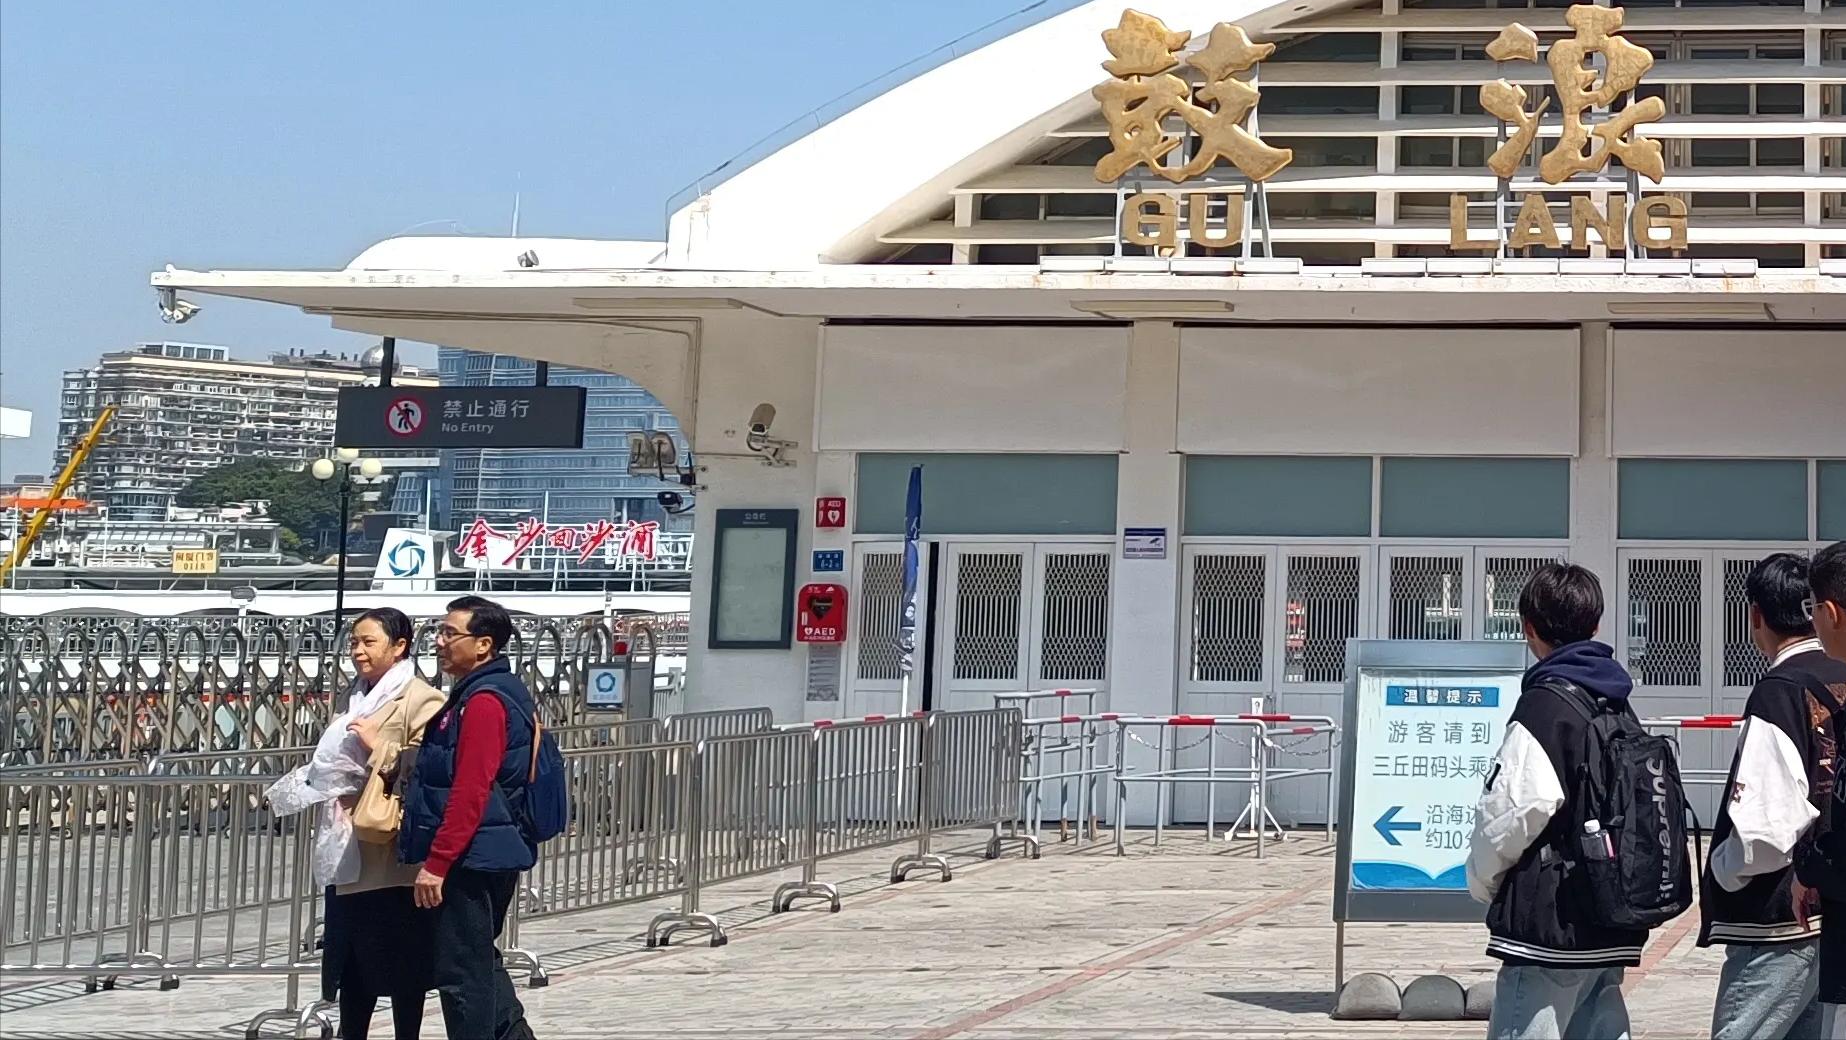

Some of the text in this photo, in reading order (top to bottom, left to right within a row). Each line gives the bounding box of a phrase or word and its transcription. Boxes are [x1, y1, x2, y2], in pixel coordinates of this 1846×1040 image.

[1122, 193, 1245, 248] GU
[1450, 193, 1688, 250] LANG
[443, 400, 530, 418] 禁止通行
[441, 423, 494, 434] No Entry
[1403, 689, 1483, 704] 温馨提示
[1388, 721, 1491, 744] 游客请到
